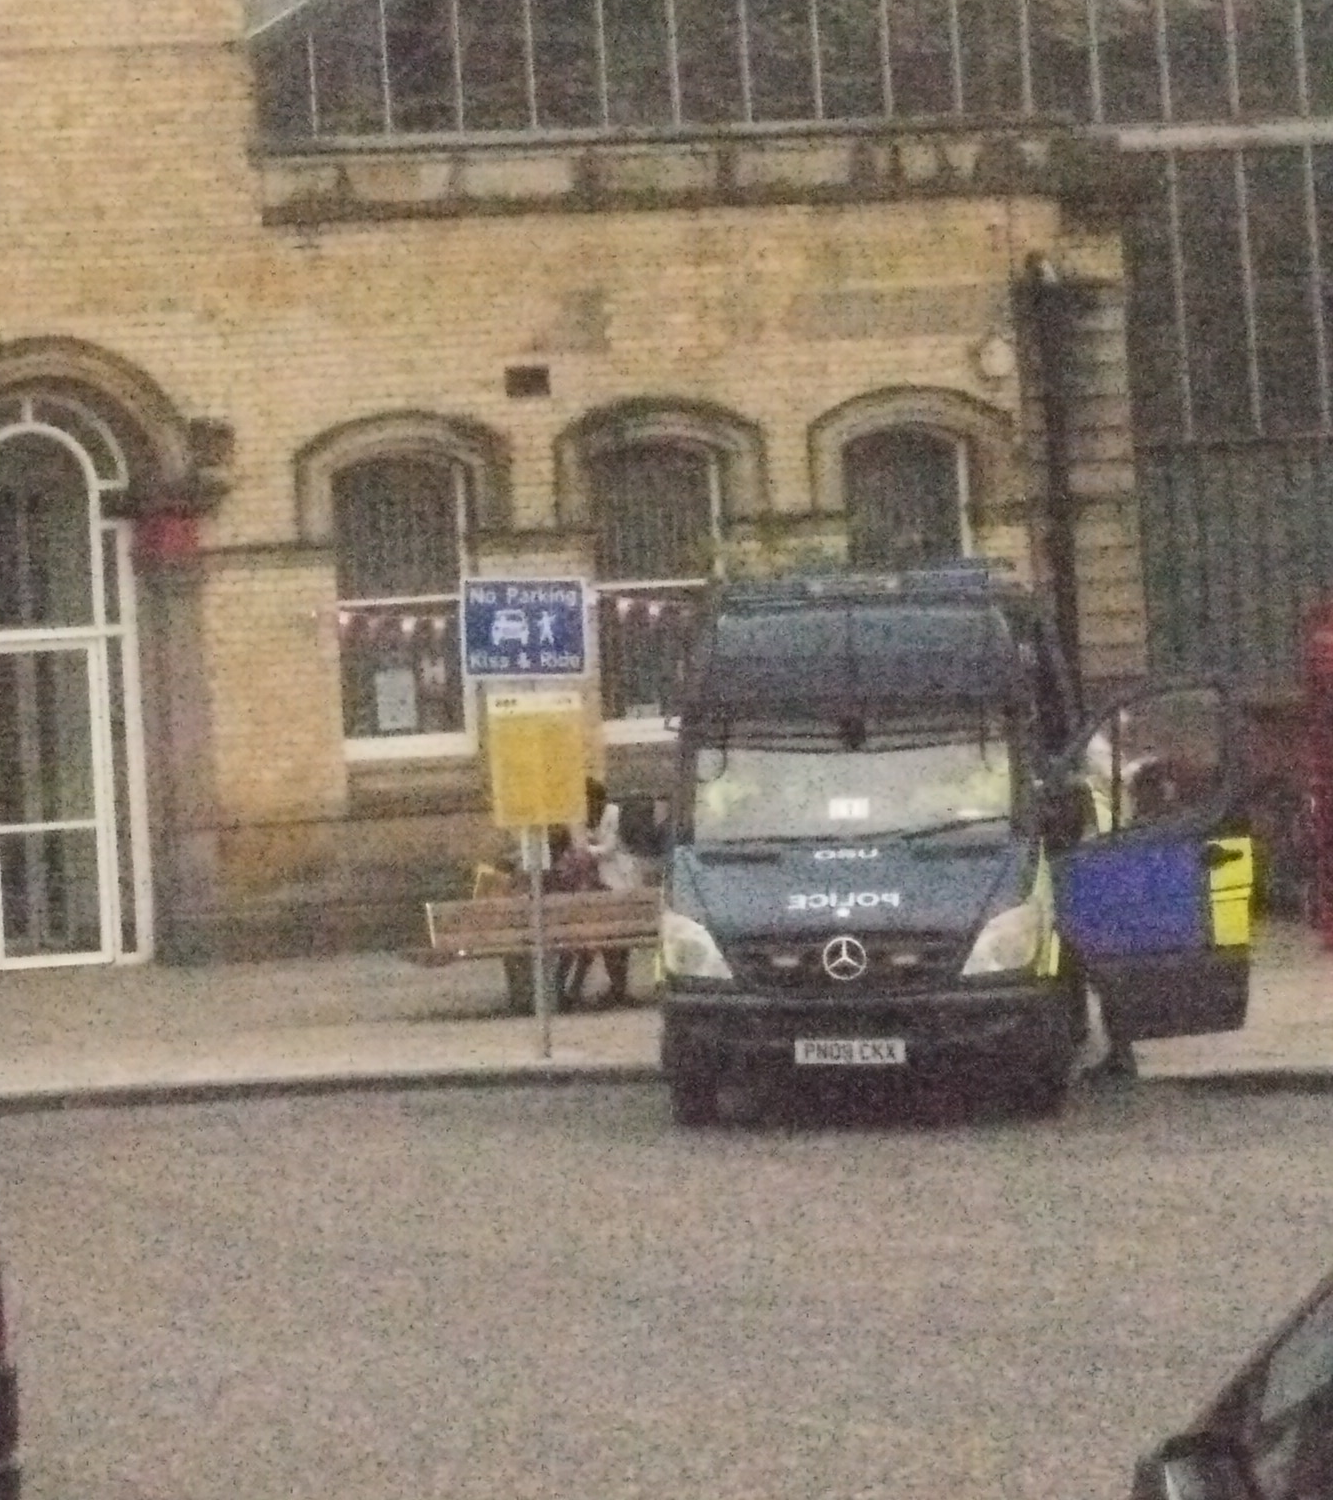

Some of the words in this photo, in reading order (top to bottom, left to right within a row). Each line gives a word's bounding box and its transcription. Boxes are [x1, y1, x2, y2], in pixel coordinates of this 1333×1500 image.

[469, 588, 497, 604] No
[506, 587, 578, 607] Parking
[469, 650, 510, 669] Kiss
[539, 650, 581, 669] Ride
